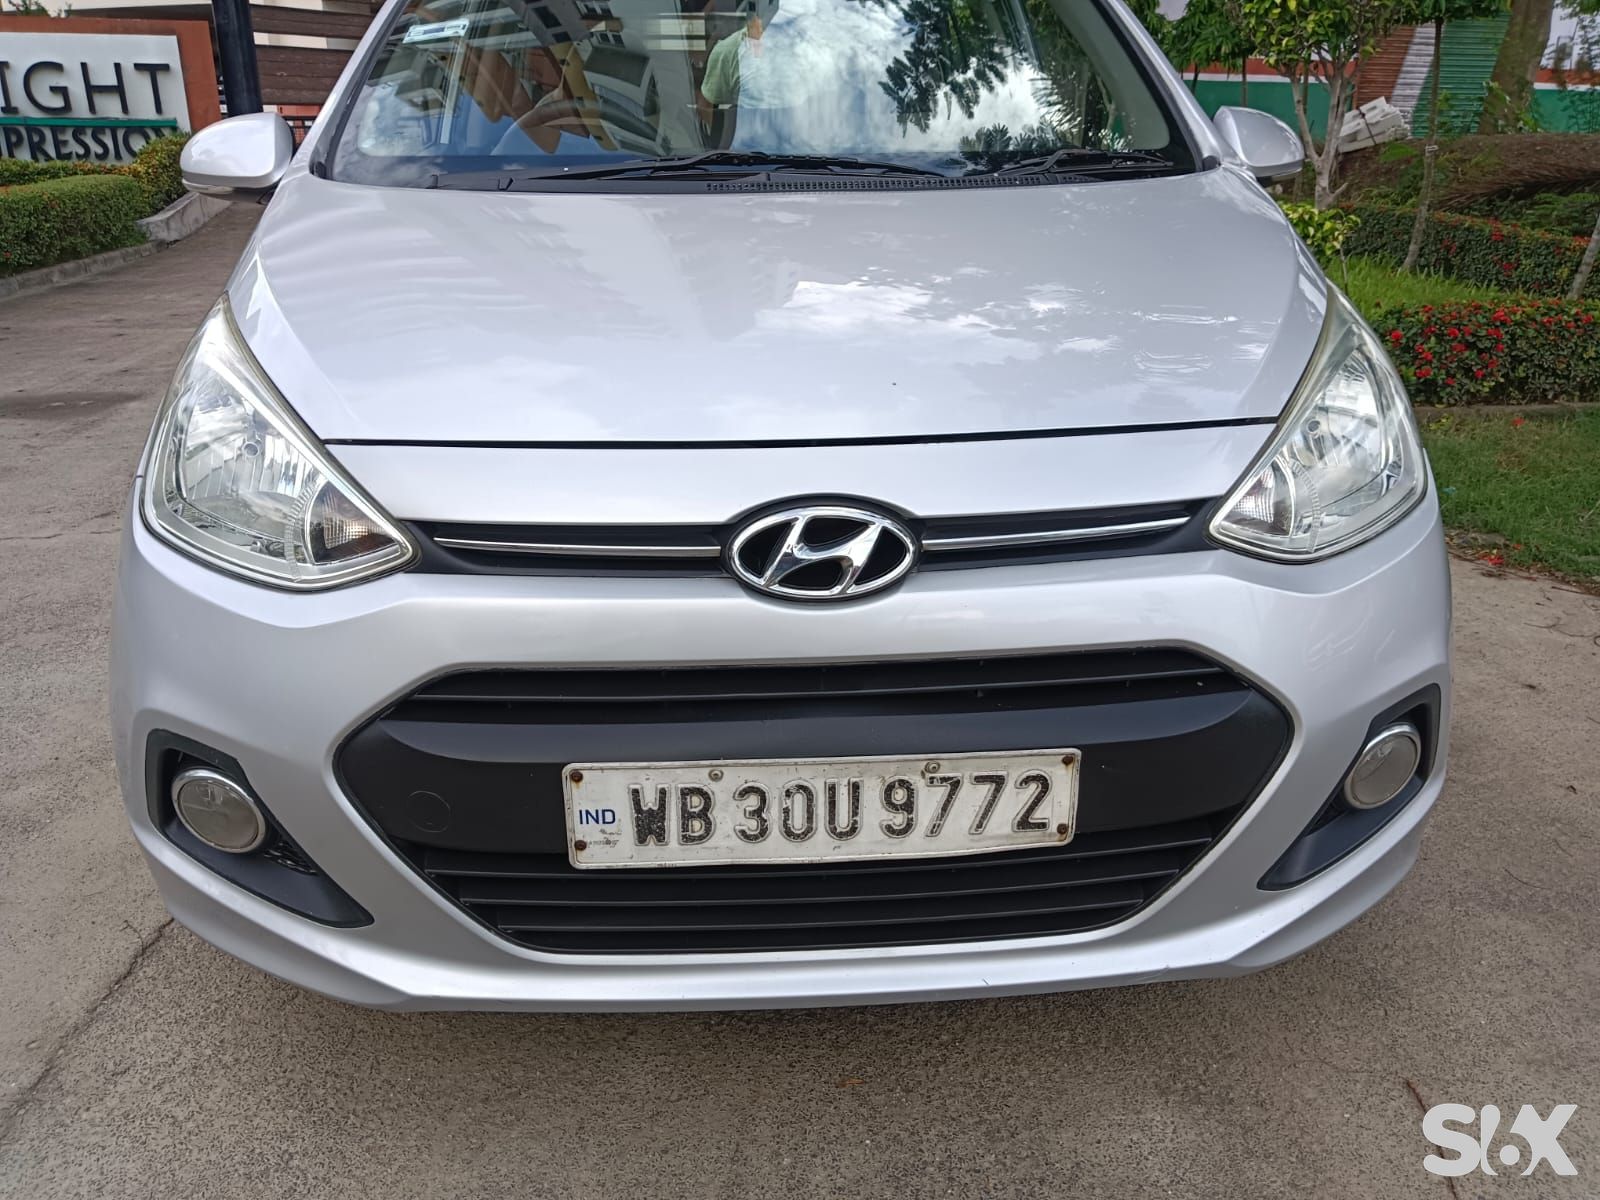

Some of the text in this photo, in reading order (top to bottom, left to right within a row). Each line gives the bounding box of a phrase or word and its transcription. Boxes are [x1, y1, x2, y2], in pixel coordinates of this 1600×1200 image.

[0, 60, 170, 115] IGHT
[0, 126, 166, 162] PRESSIO
[578, 808, 617, 825] IND
